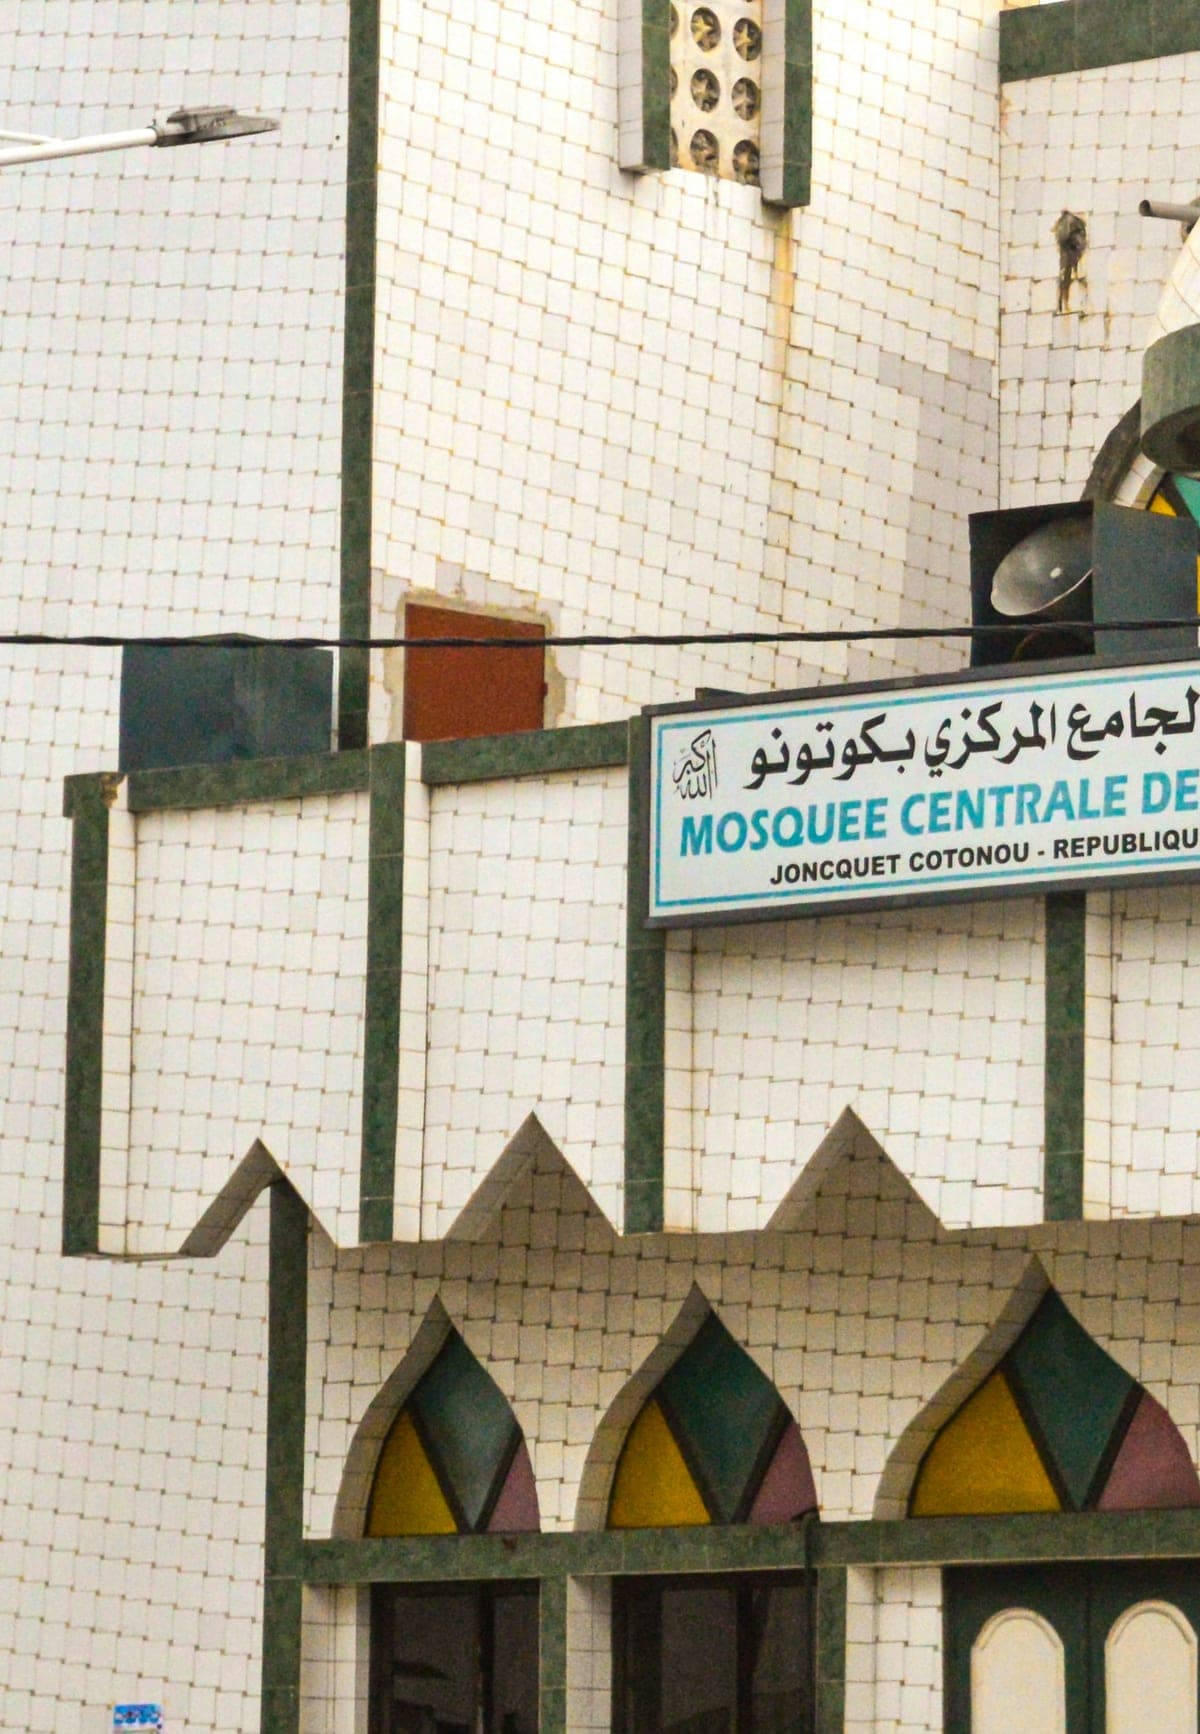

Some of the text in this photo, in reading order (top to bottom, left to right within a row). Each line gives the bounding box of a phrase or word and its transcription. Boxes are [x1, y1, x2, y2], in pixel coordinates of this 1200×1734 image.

[743, 713, 916, 790] بكوتونو
[924, 701, 1057, 778] المركزي
[679, 797, 889, 858] MOSQUEE
[900, 774, 1129, 837] CENTRALE
[1141, 768, 1200, 815] DE
[770, 853, 901, 885] JONCQUET
[909, 842, 1029, 873] COTONOU
